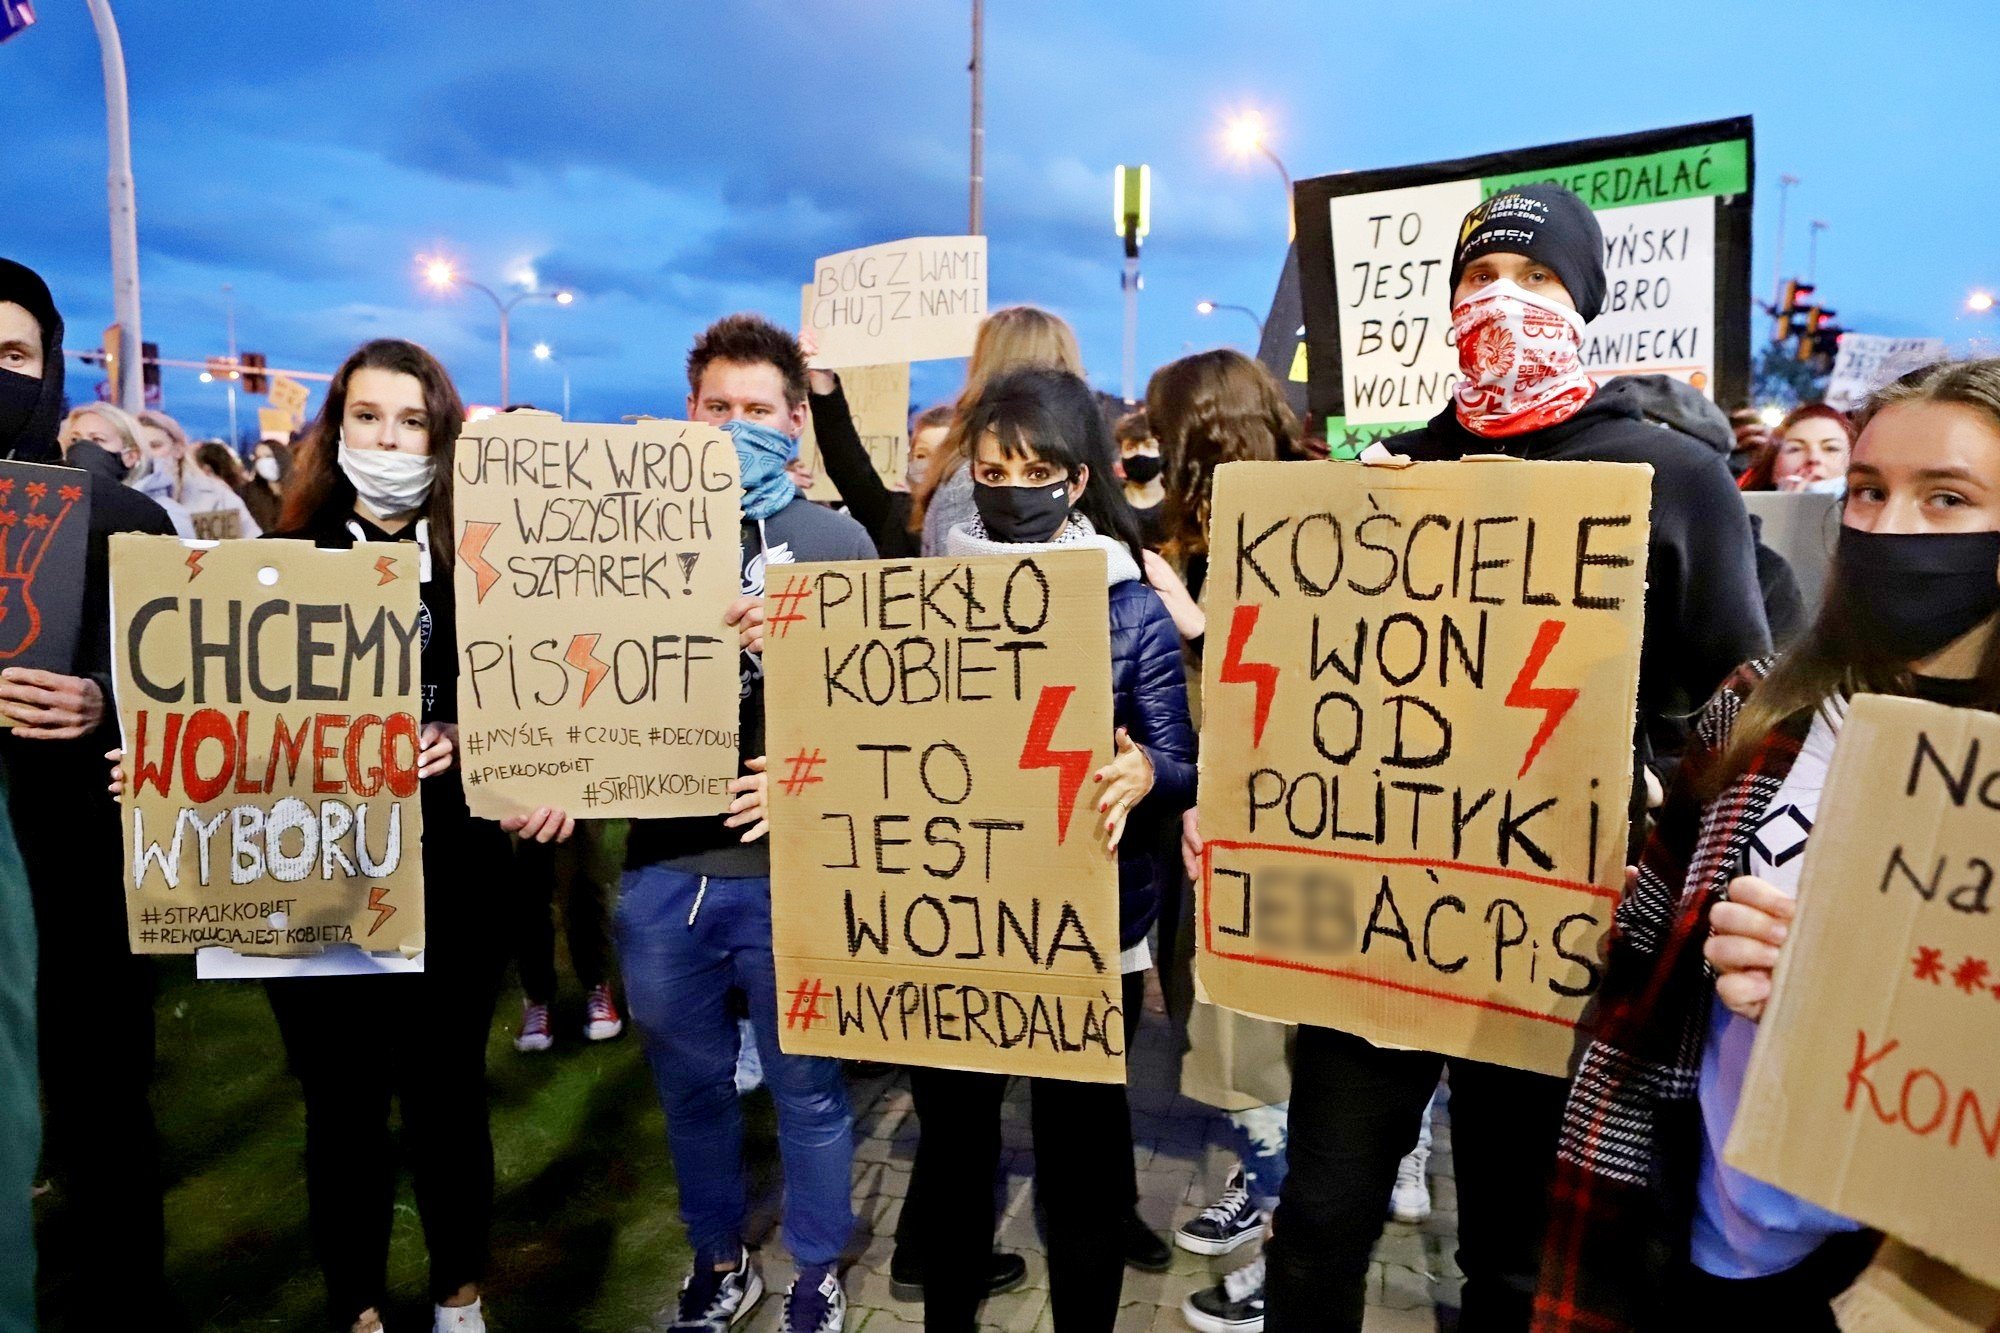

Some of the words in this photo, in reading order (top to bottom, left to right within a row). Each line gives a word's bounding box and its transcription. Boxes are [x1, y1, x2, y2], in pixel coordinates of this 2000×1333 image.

[1486, 148, 1712, 204] ERDALAĆ
[1368, 212, 1422, 249] TO
[1604, 223, 1689, 269] YŃSKI
[818, 256, 878, 298] BÓG
[886, 251, 910, 286] Z
[918, 250, 981, 282] WAMI
[1350, 259, 1442, 308] JEST
[812, 295, 884, 337] CHUJ
[890, 291, 911, 321] Z
[920, 288, 980, 317] NAMI
[1357, 311, 1429, 367] BÓJ
[457, 436, 592, 490] JAREK
[606, 428, 733, 493] WRÓG
[508, 551, 700, 600] SZPAREK!
[1236, 493, 1634, 611] KOŚCIELE
[767, 558, 1050, 638] #PIEKŁO
[129, 597, 419, 703] CHCEMY
[465, 635, 570, 709] PiS
[614, 635, 723, 705] OFF
[824, 636, 1048, 706] KOBIET
[1310, 609, 1488, 689] WON
[134, 708, 419, 803] WOLNEGO
[467, 722, 553, 755] #MYŚLĘ
[1312, 691, 1453, 769] OD
[857, 740, 972, 805] TO
[133, 797, 402, 890] WYBORU
[822, 814, 1025, 882] JEST
[141, 898, 297, 924] #STRAJKKOBIET
[845, 889, 1108, 974] WOJNA
[1214, 867, 1468, 973] JAĆ
[786, 979, 1124, 1057] #WYPIERDALAĆ
